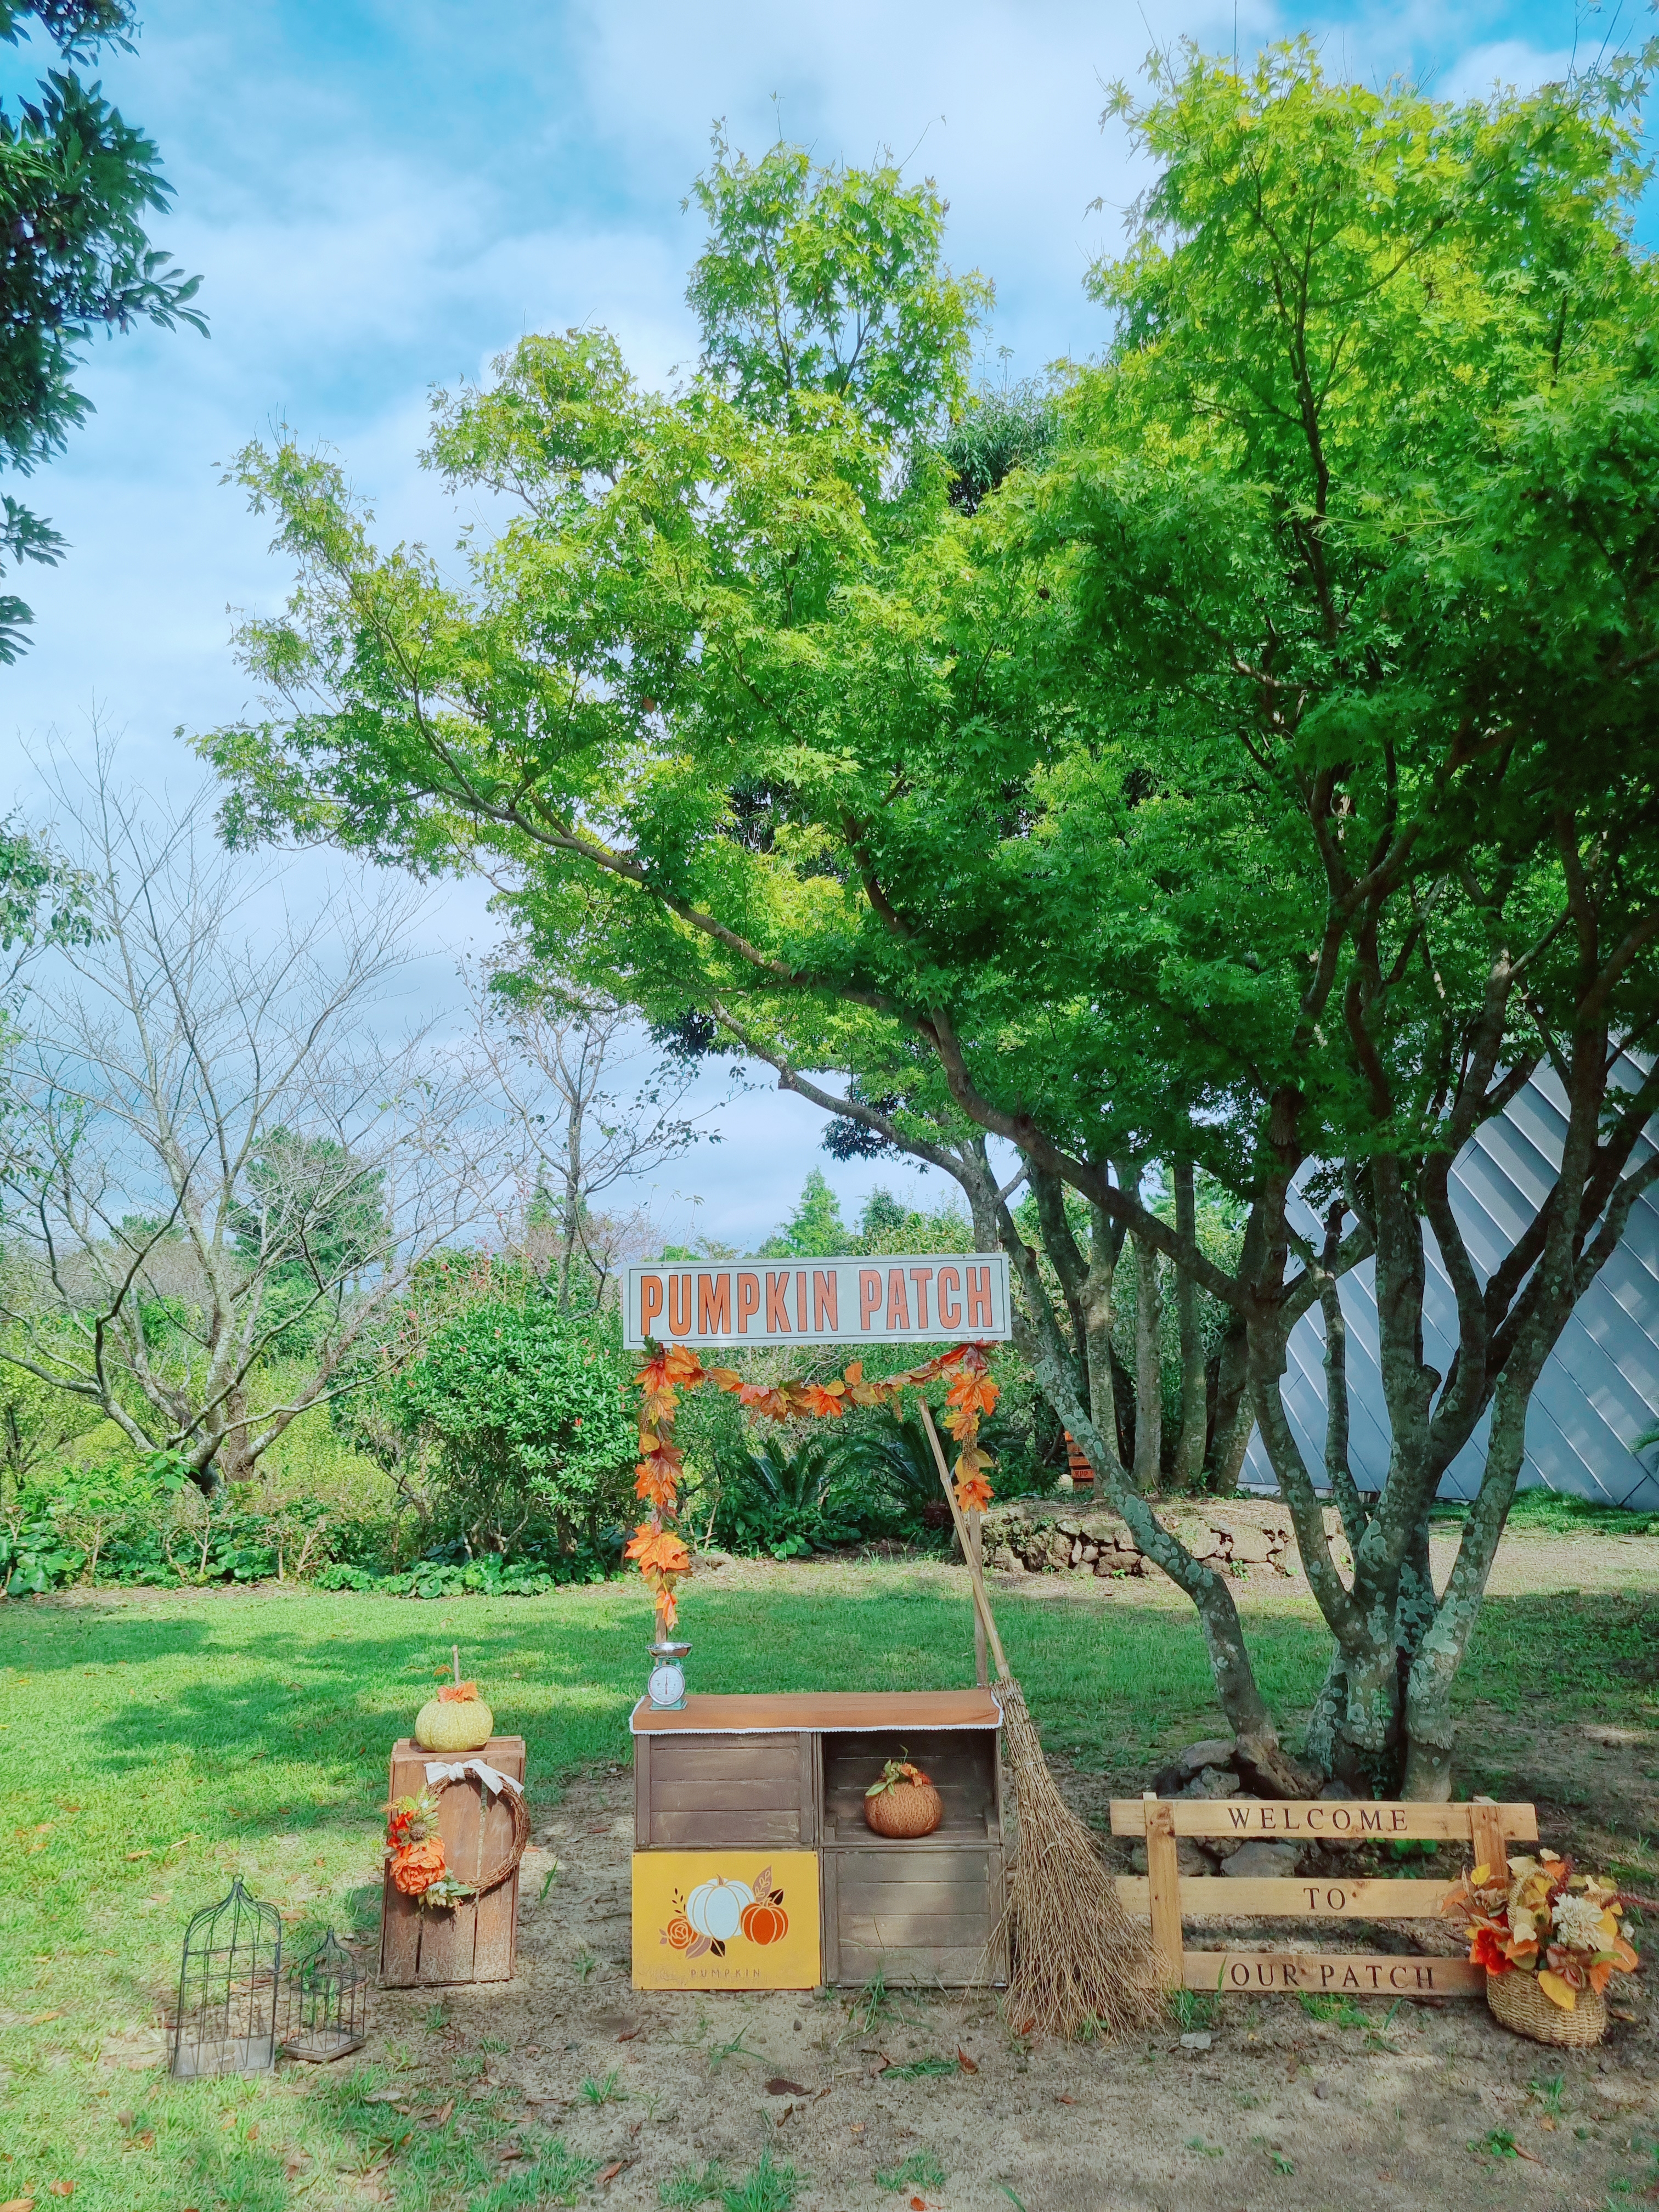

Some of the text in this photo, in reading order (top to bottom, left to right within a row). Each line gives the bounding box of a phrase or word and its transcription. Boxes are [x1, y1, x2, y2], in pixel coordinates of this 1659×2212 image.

[640, 1266, 993, 1336] PUMPKIN PATCH
[1227, 1807, 1408, 1831] WELCOME
[1303, 1887, 1345, 1910] TO
[691, 1968, 760, 1978] PUMPKIN
[1231, 1963, 1434, 1990] OUR PATCH
